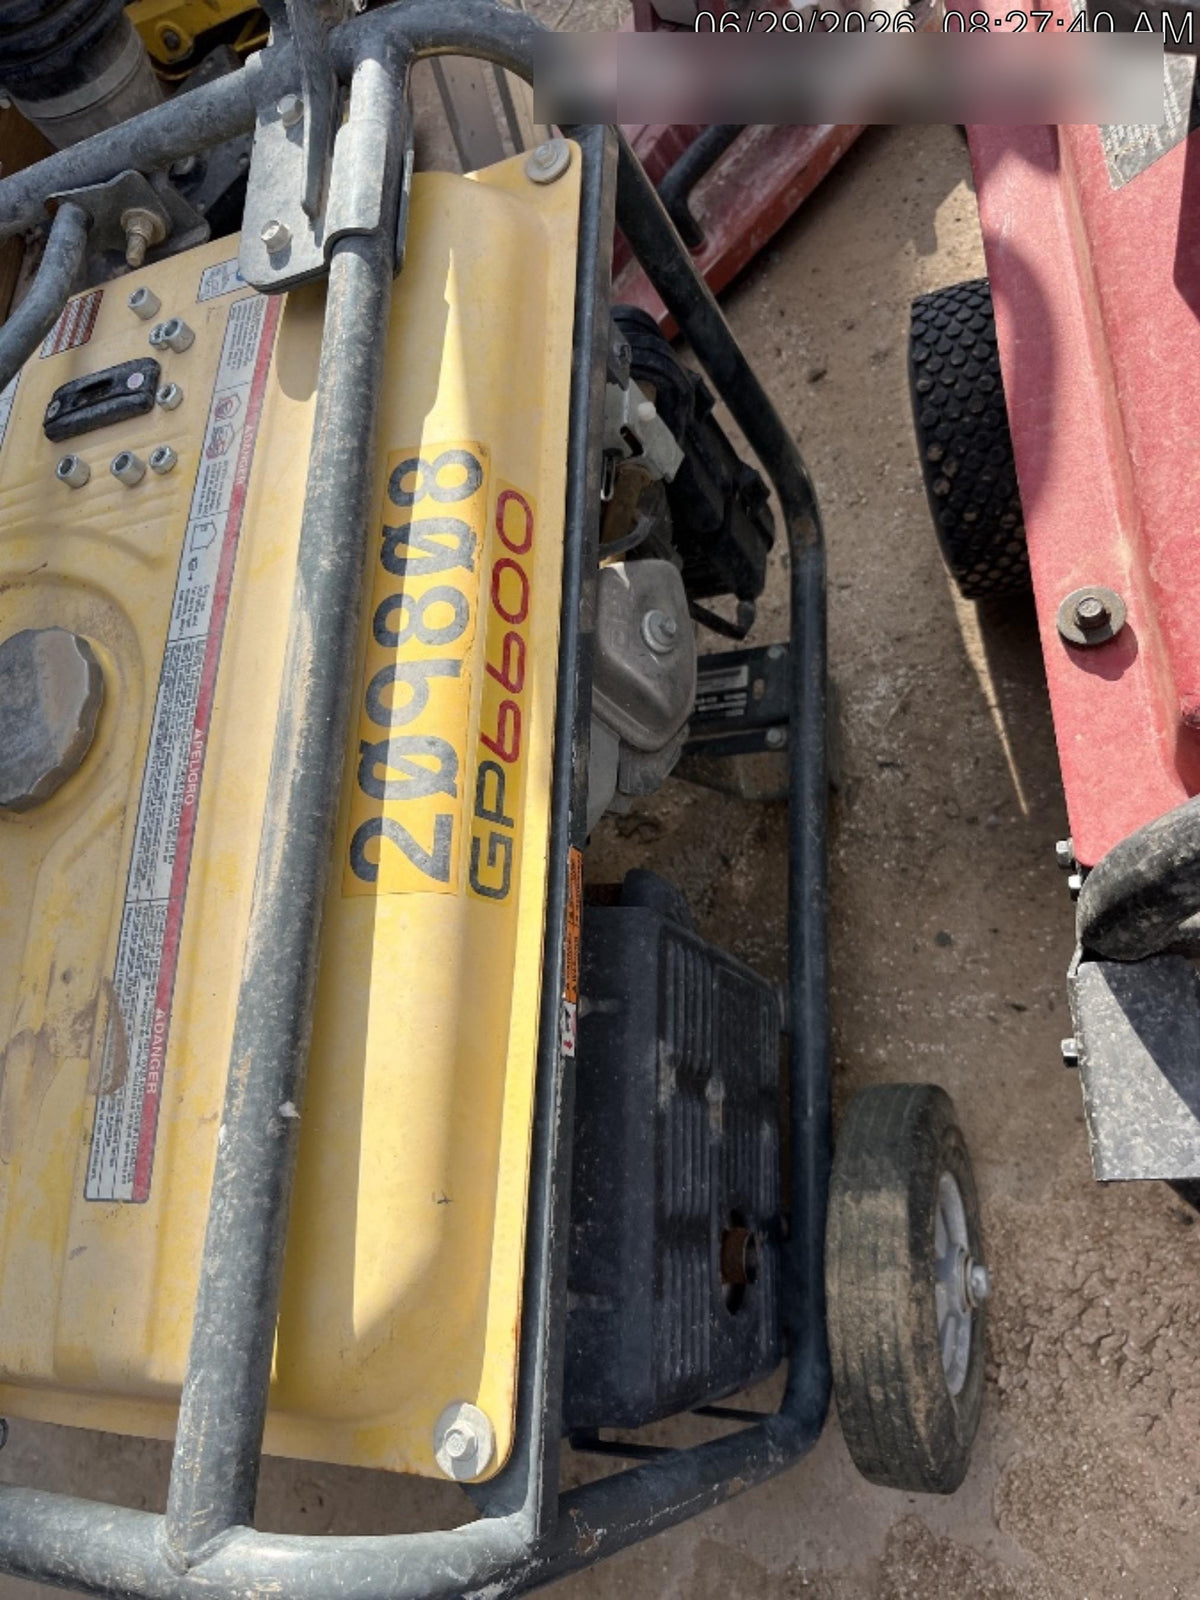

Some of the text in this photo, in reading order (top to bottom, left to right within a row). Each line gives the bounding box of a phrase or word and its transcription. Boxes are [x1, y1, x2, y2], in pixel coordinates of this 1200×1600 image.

[469, 489, 535, 900] GP6600
[184, 741, 204, 805] PELIGRO
[146, 1023, 165, 1094] DANGER
